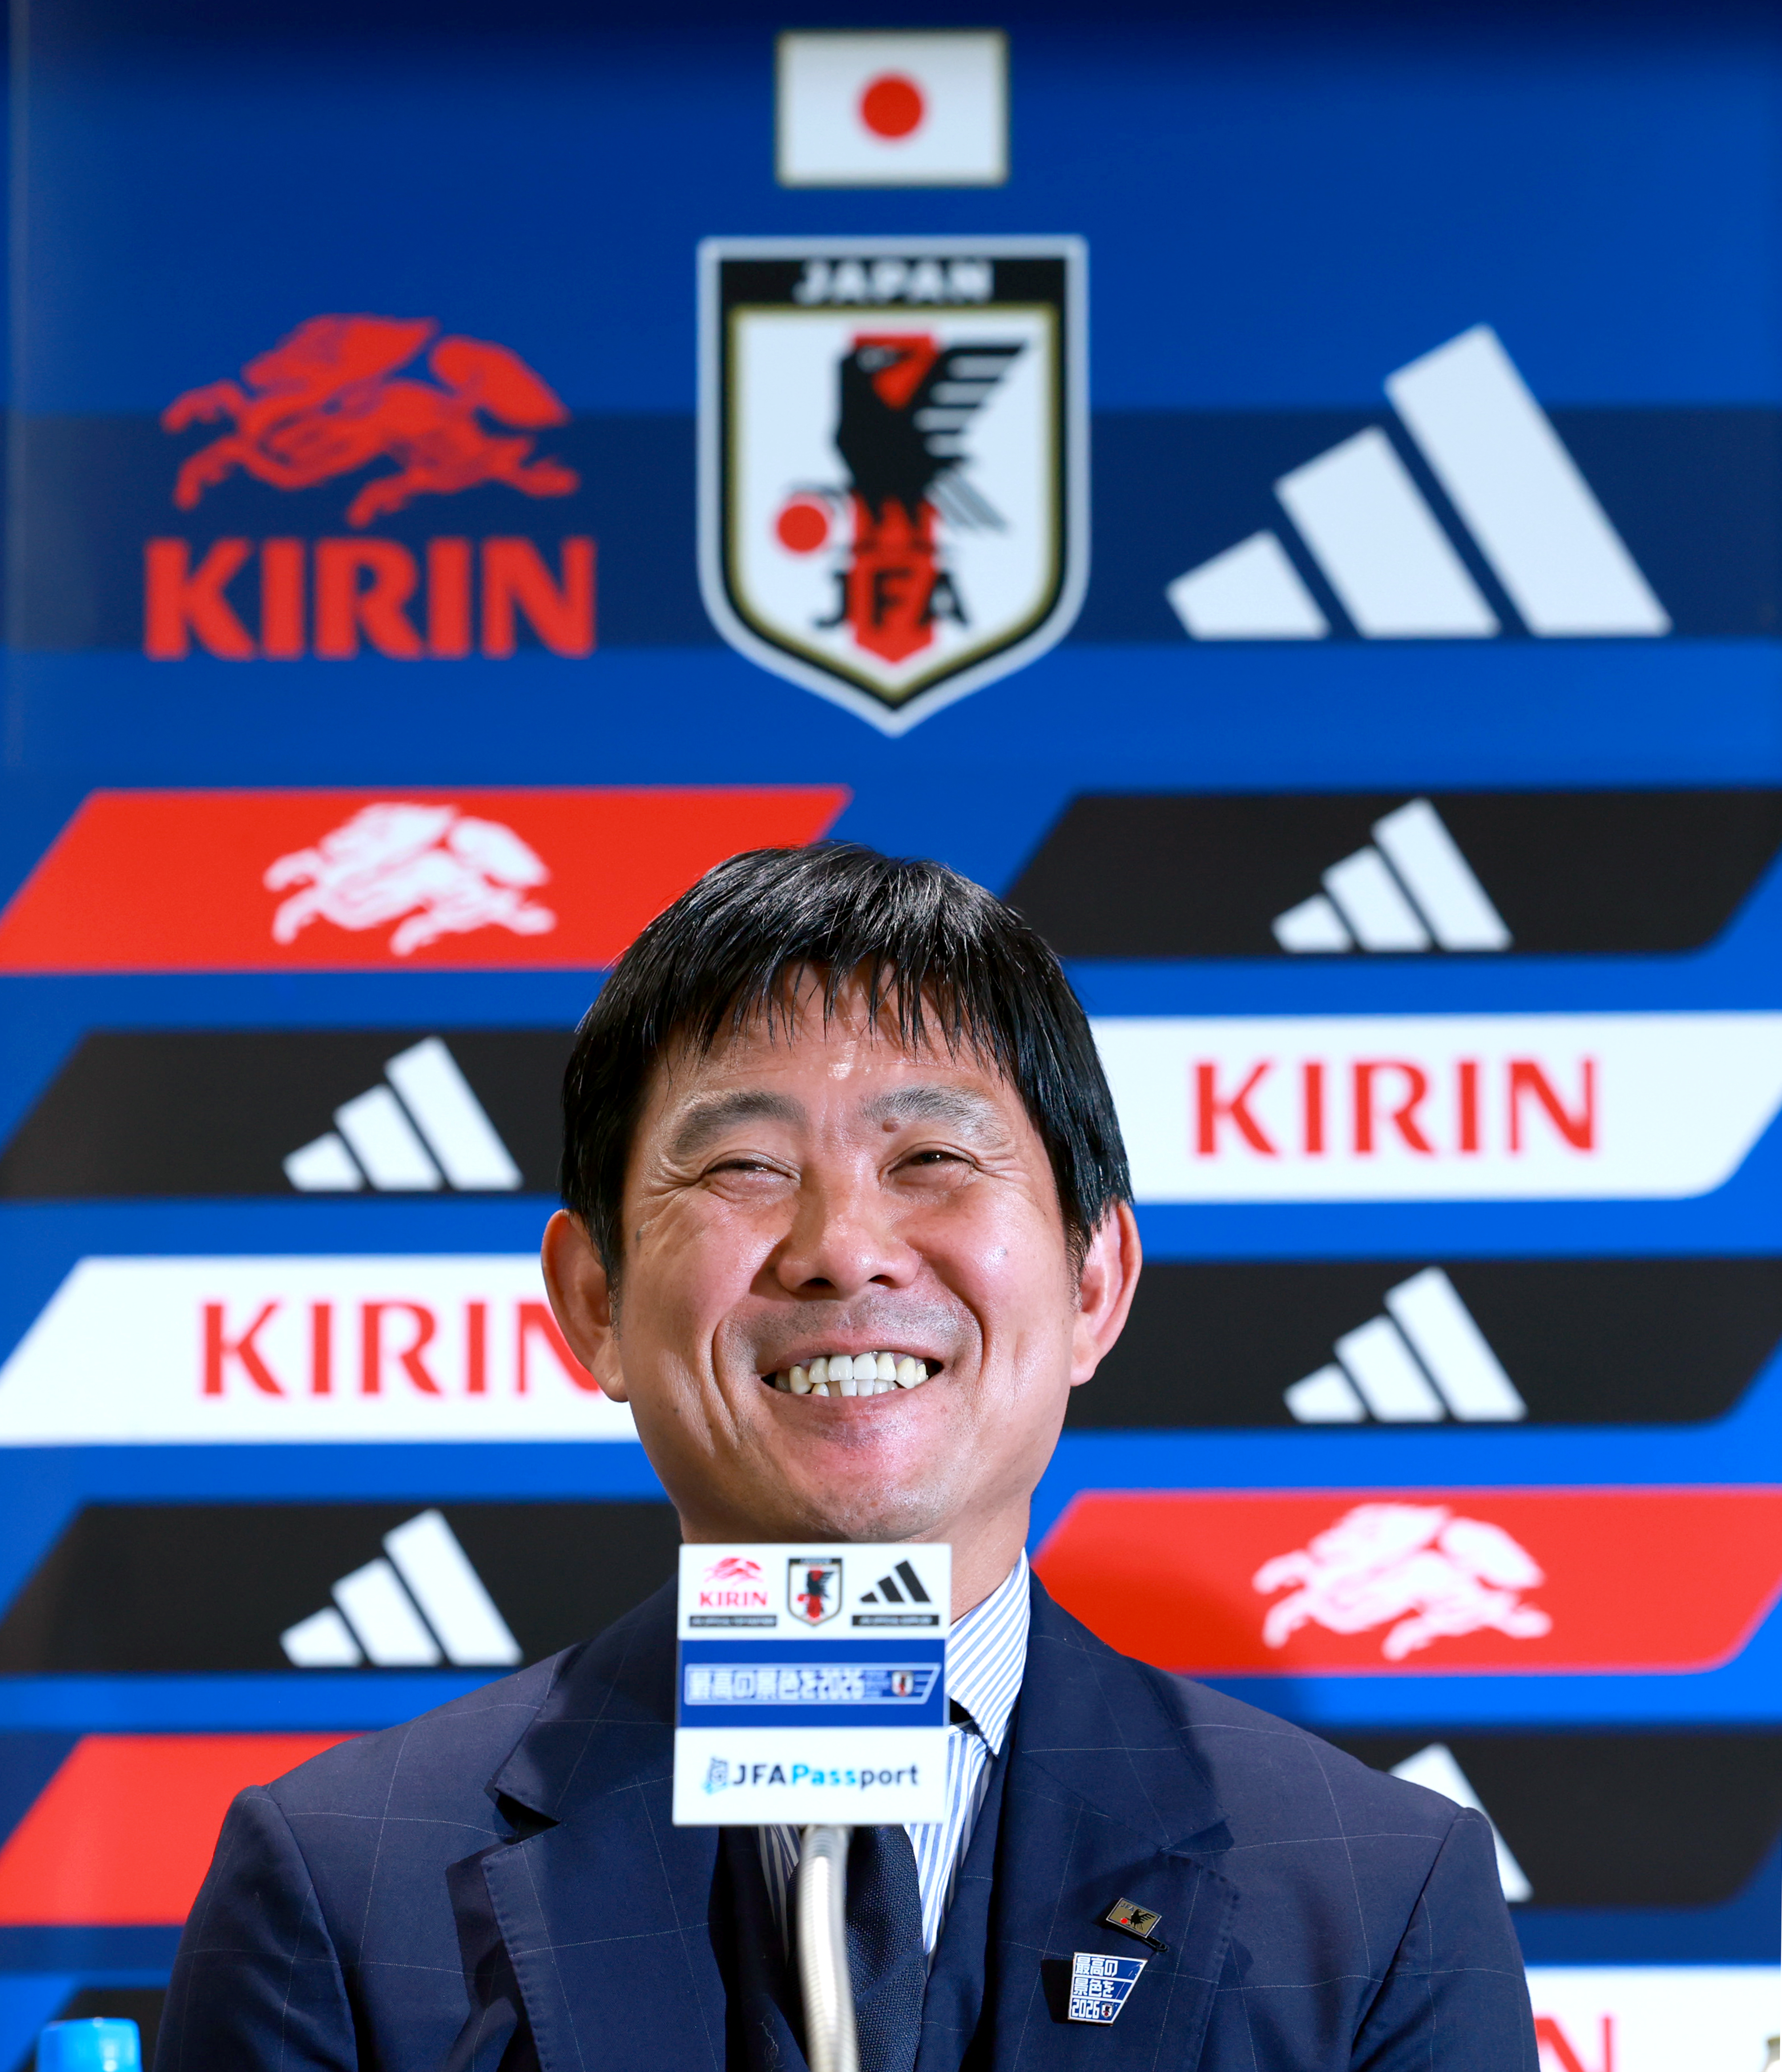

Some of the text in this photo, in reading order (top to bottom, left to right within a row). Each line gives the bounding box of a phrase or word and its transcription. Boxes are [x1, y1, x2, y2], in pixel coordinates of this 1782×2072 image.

[795, 259, 993, 303] JAPAN
[144, 536, 597, 660] KIRIN
[811, 571, 971, 630] JFA
[1194, 1058, 1597, 1158] KIRIN
[699, 1591, 767, 1607] KIRIN
[1075, 1956, 1118, 1977] 最高の
[1073, 1977, 1114, 1998] 景色を
[1071, 1999, 1100, 2019] 2026
